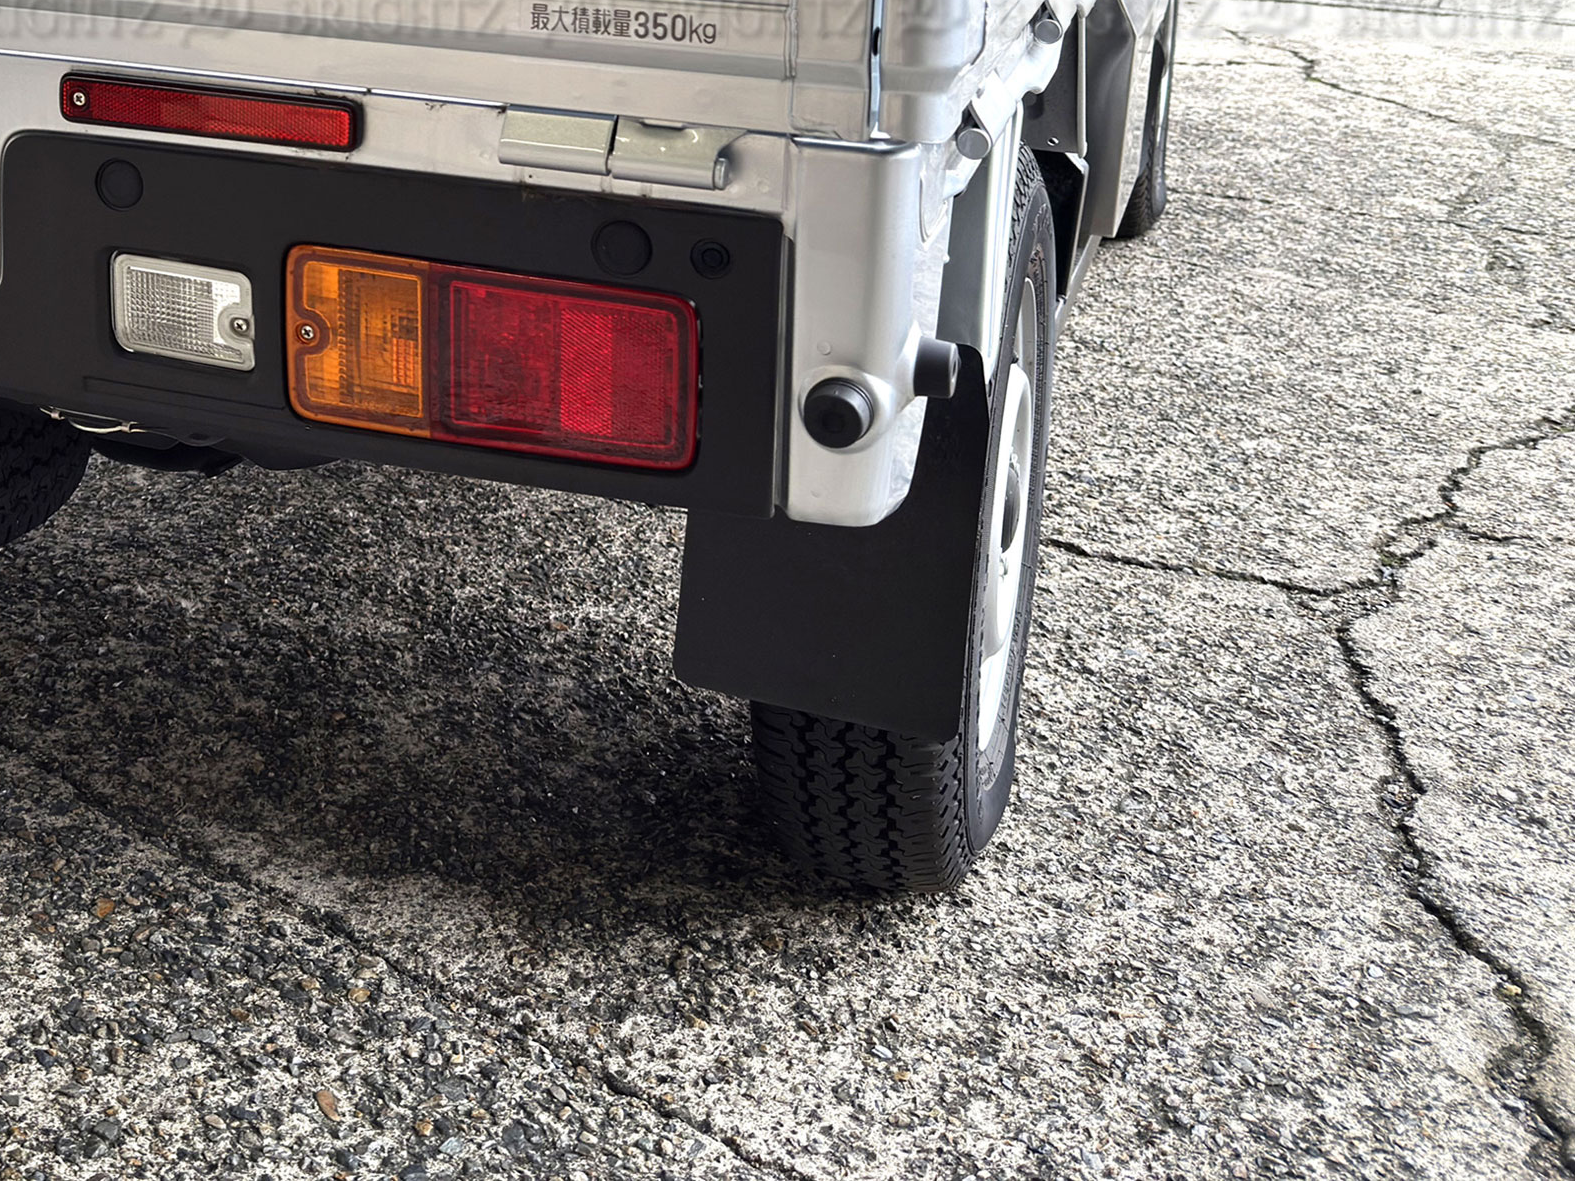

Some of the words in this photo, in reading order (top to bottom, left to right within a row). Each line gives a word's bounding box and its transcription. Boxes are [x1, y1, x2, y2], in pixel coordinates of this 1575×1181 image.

[530, 2, 717, 45] 最大積載量350kg
